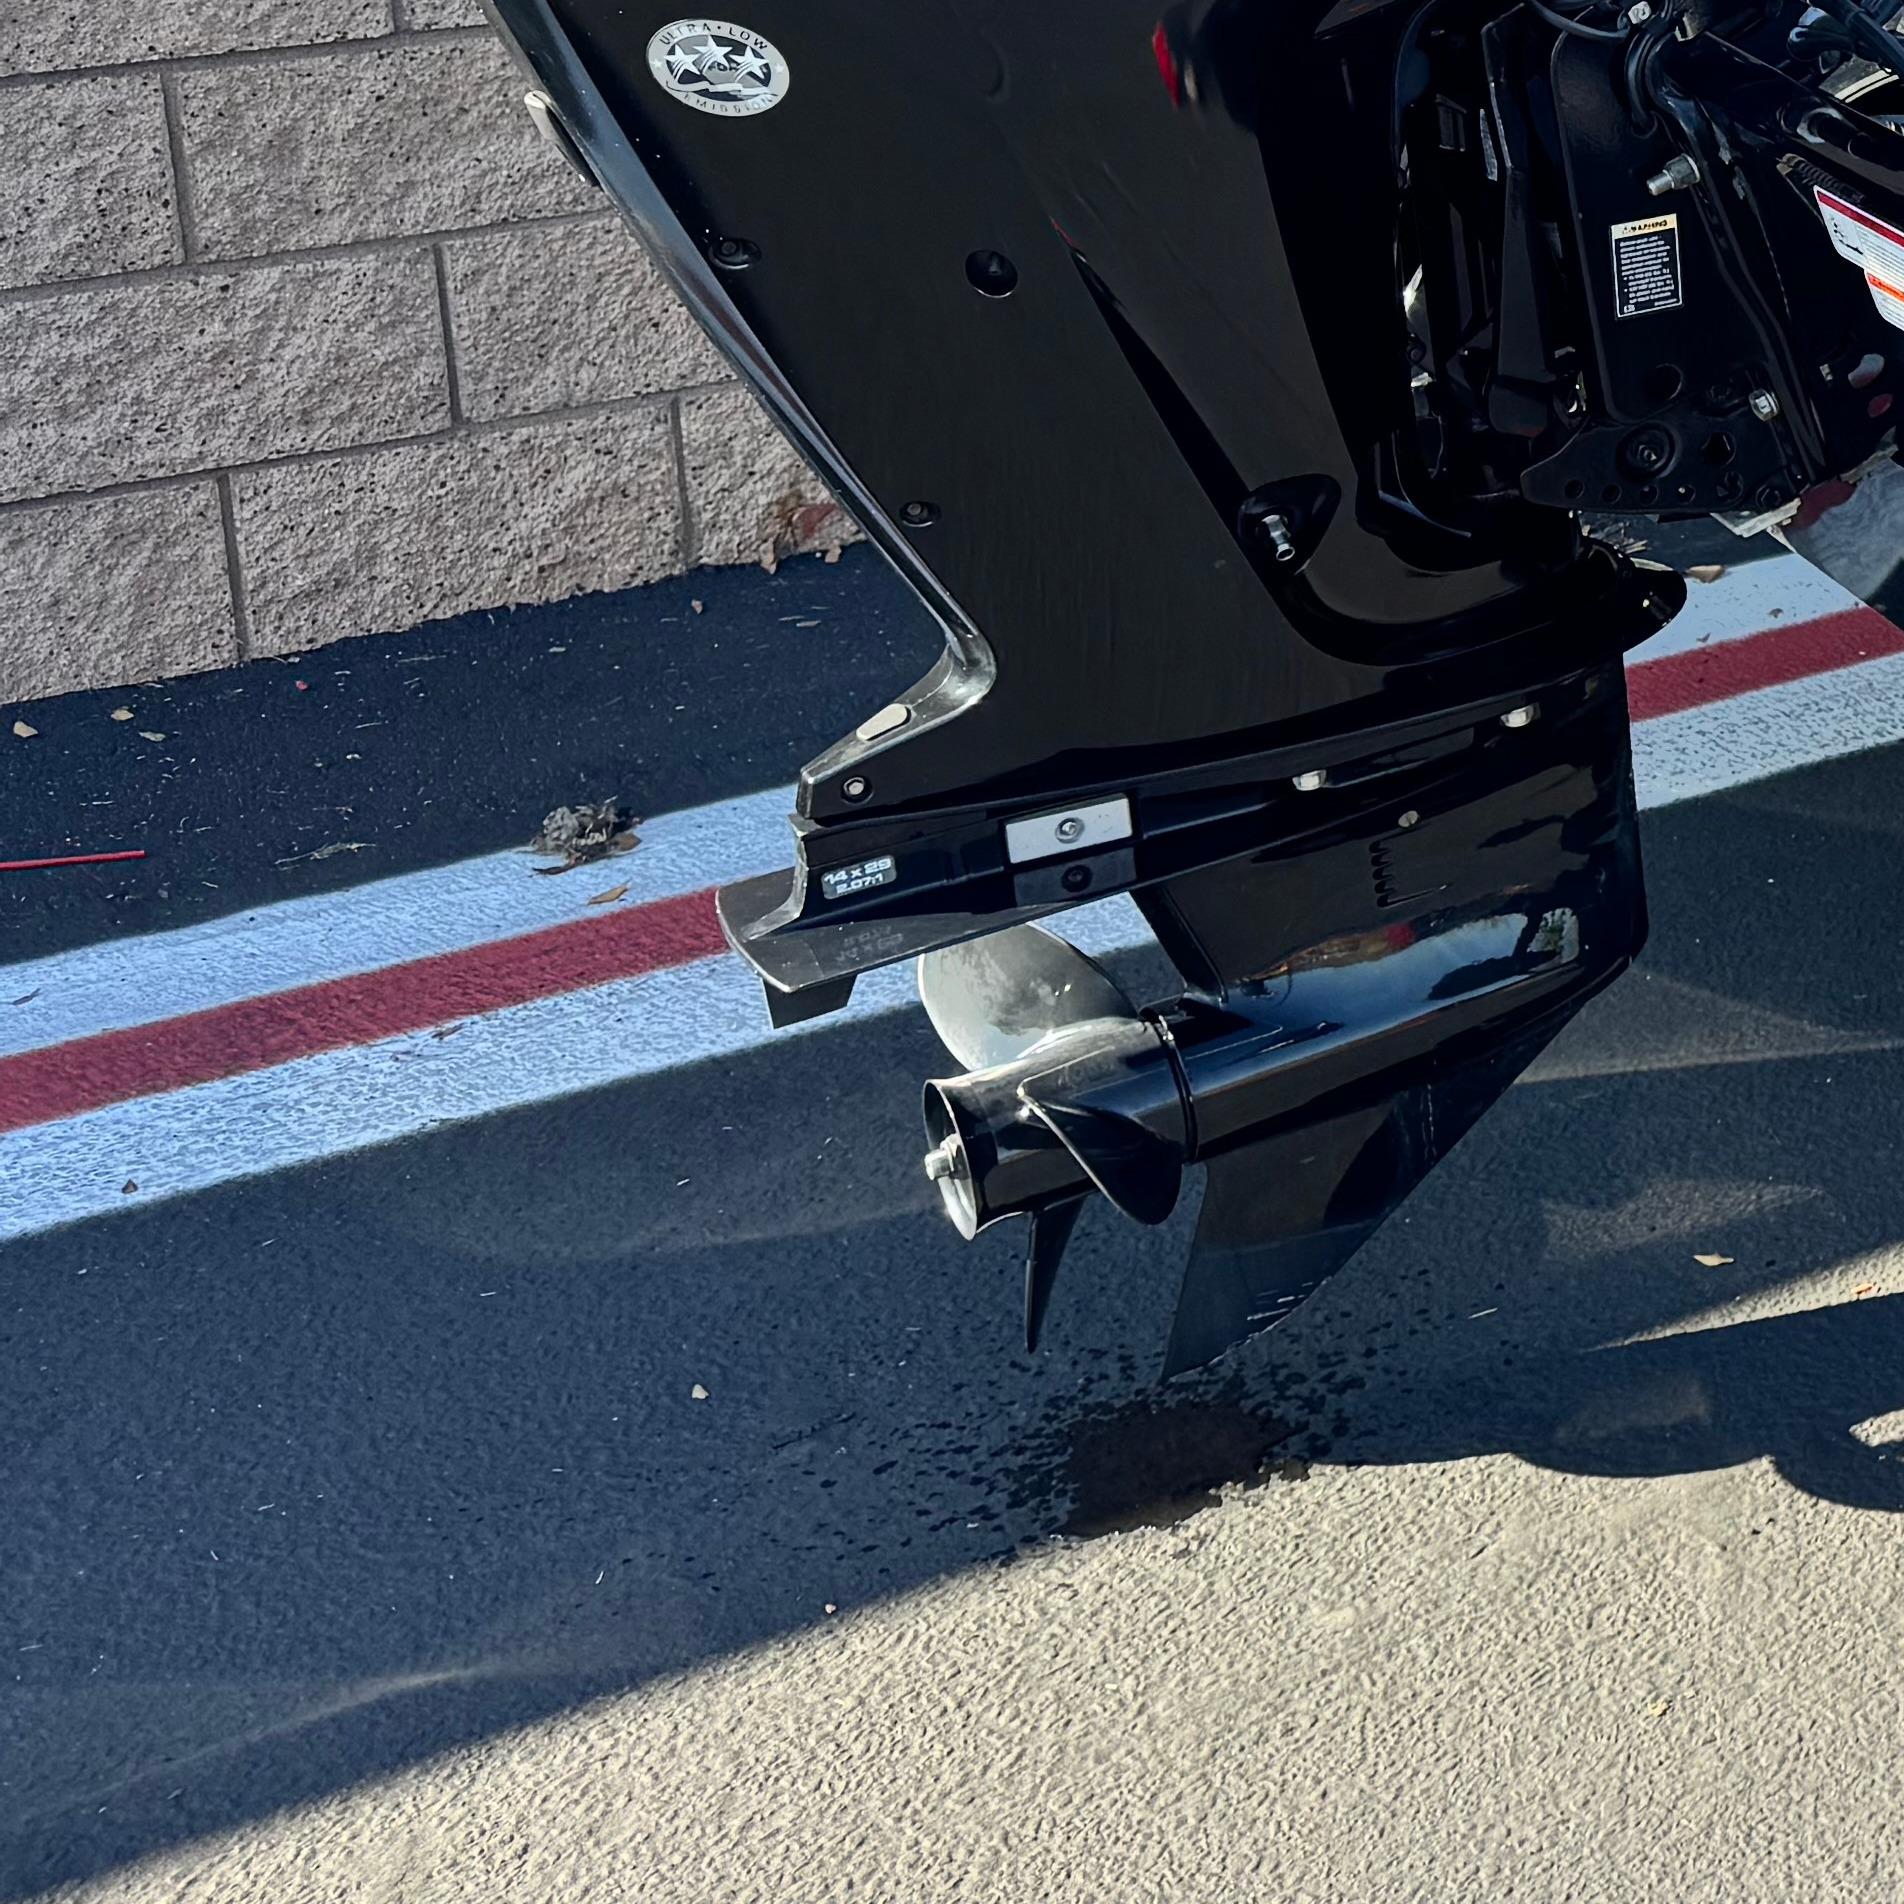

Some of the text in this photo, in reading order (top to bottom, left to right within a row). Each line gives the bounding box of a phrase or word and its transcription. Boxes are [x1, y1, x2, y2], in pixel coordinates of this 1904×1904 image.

[659, 22, 768, 50] ULTRA LOW
[824, 870, 848, 885] 14
